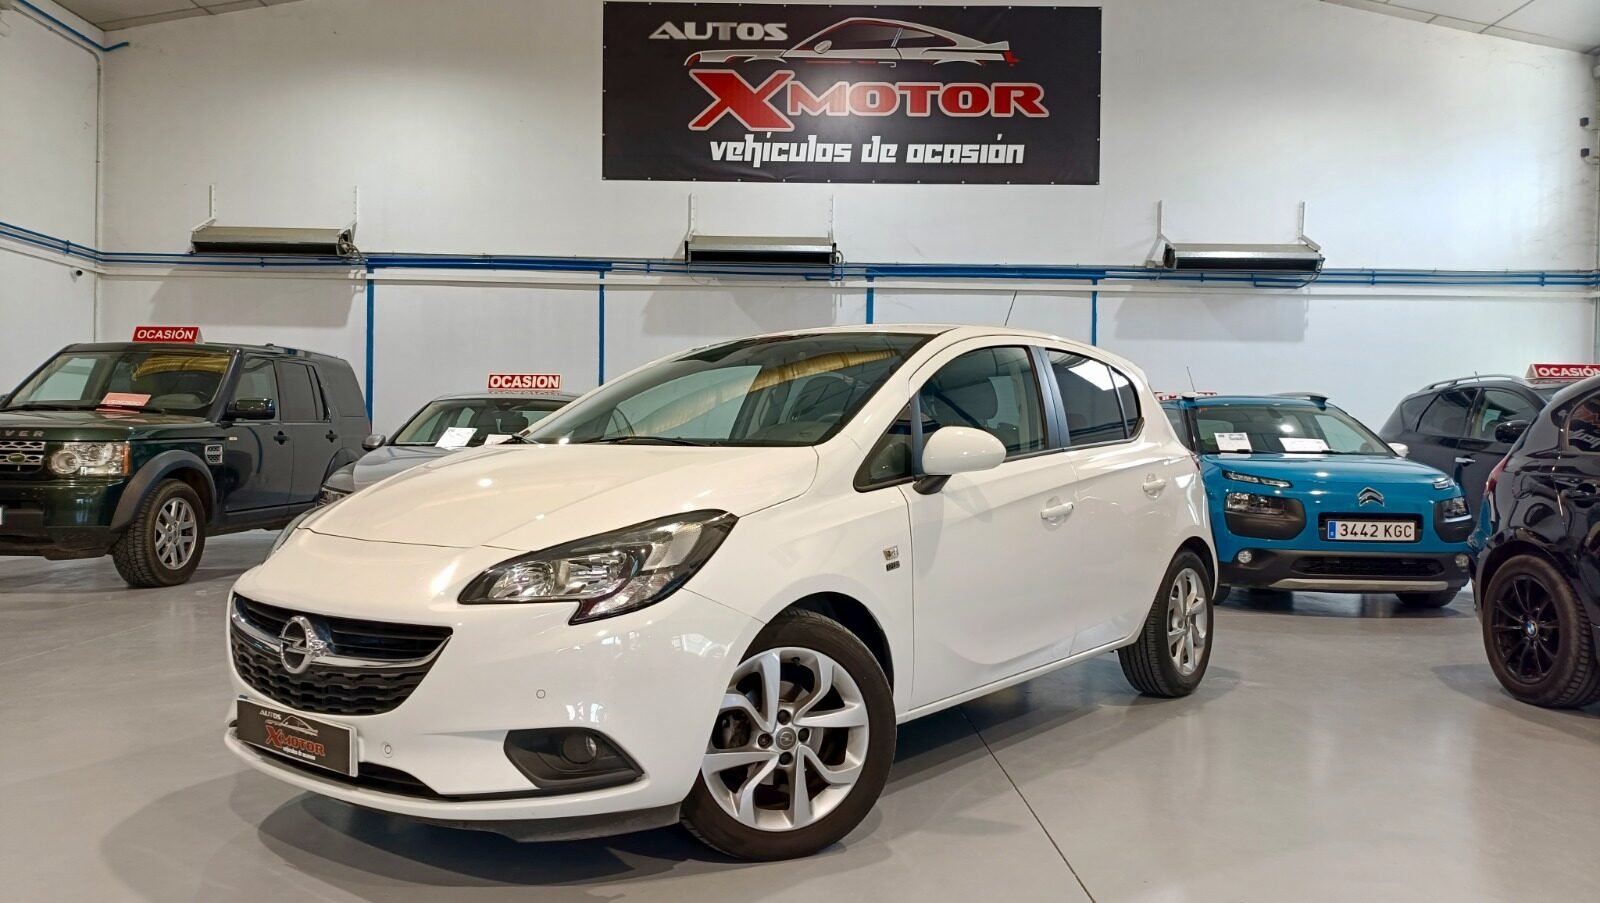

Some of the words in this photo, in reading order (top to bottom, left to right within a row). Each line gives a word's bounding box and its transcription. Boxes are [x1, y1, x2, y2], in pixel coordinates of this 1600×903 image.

[648, 21, 788, 41] AUTOS
[710, 132, 853, 168] vehículos
[861, 135, 898, 163] de
[906, 133, 1025, 164] ocasión
[137, 328, 194, 340] OCASIÓN
[489, 375, 560, 388] OCASION
[1340, 523, 1379, 538] 3442
[1384, 524, 1412, 538] KGC
[259, 710, 281, 720] AUTOS
